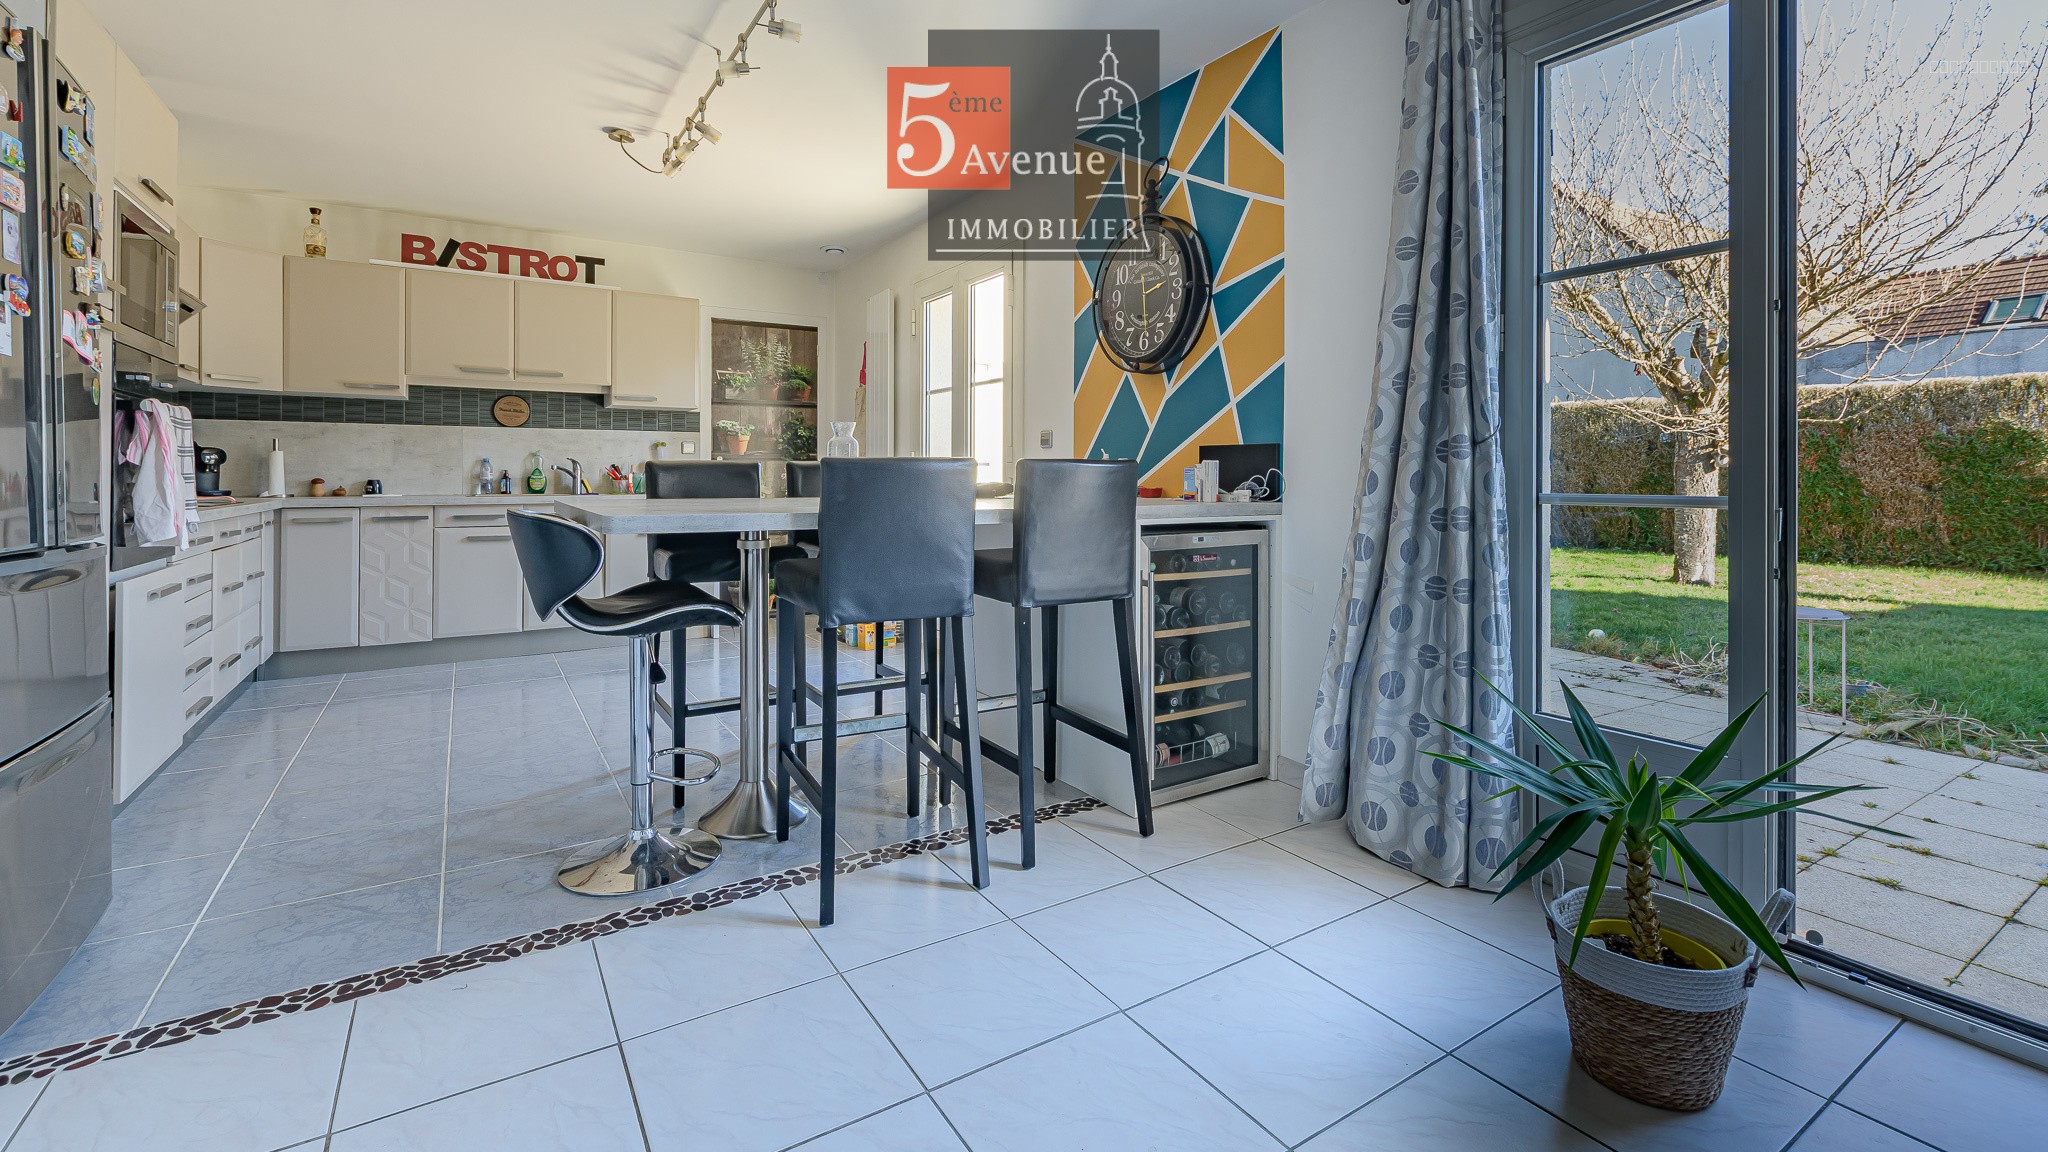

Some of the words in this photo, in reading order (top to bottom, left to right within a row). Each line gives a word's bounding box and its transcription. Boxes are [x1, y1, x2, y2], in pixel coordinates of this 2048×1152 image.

[1168, 251, 1180, 276] 2
[1115, 264, 1129, 286] 10
[1112, 290, 1122, 309] 9
[1171, 278, 1182, 300] 3
[1114, 310, 1125, 331] 8
[1165, 303, 1177, 323] 4
[1125, 327, 1135, 347] 7
[1139, 330, 1149, 351] 6
[1154, 322, 1165, 343] 5
